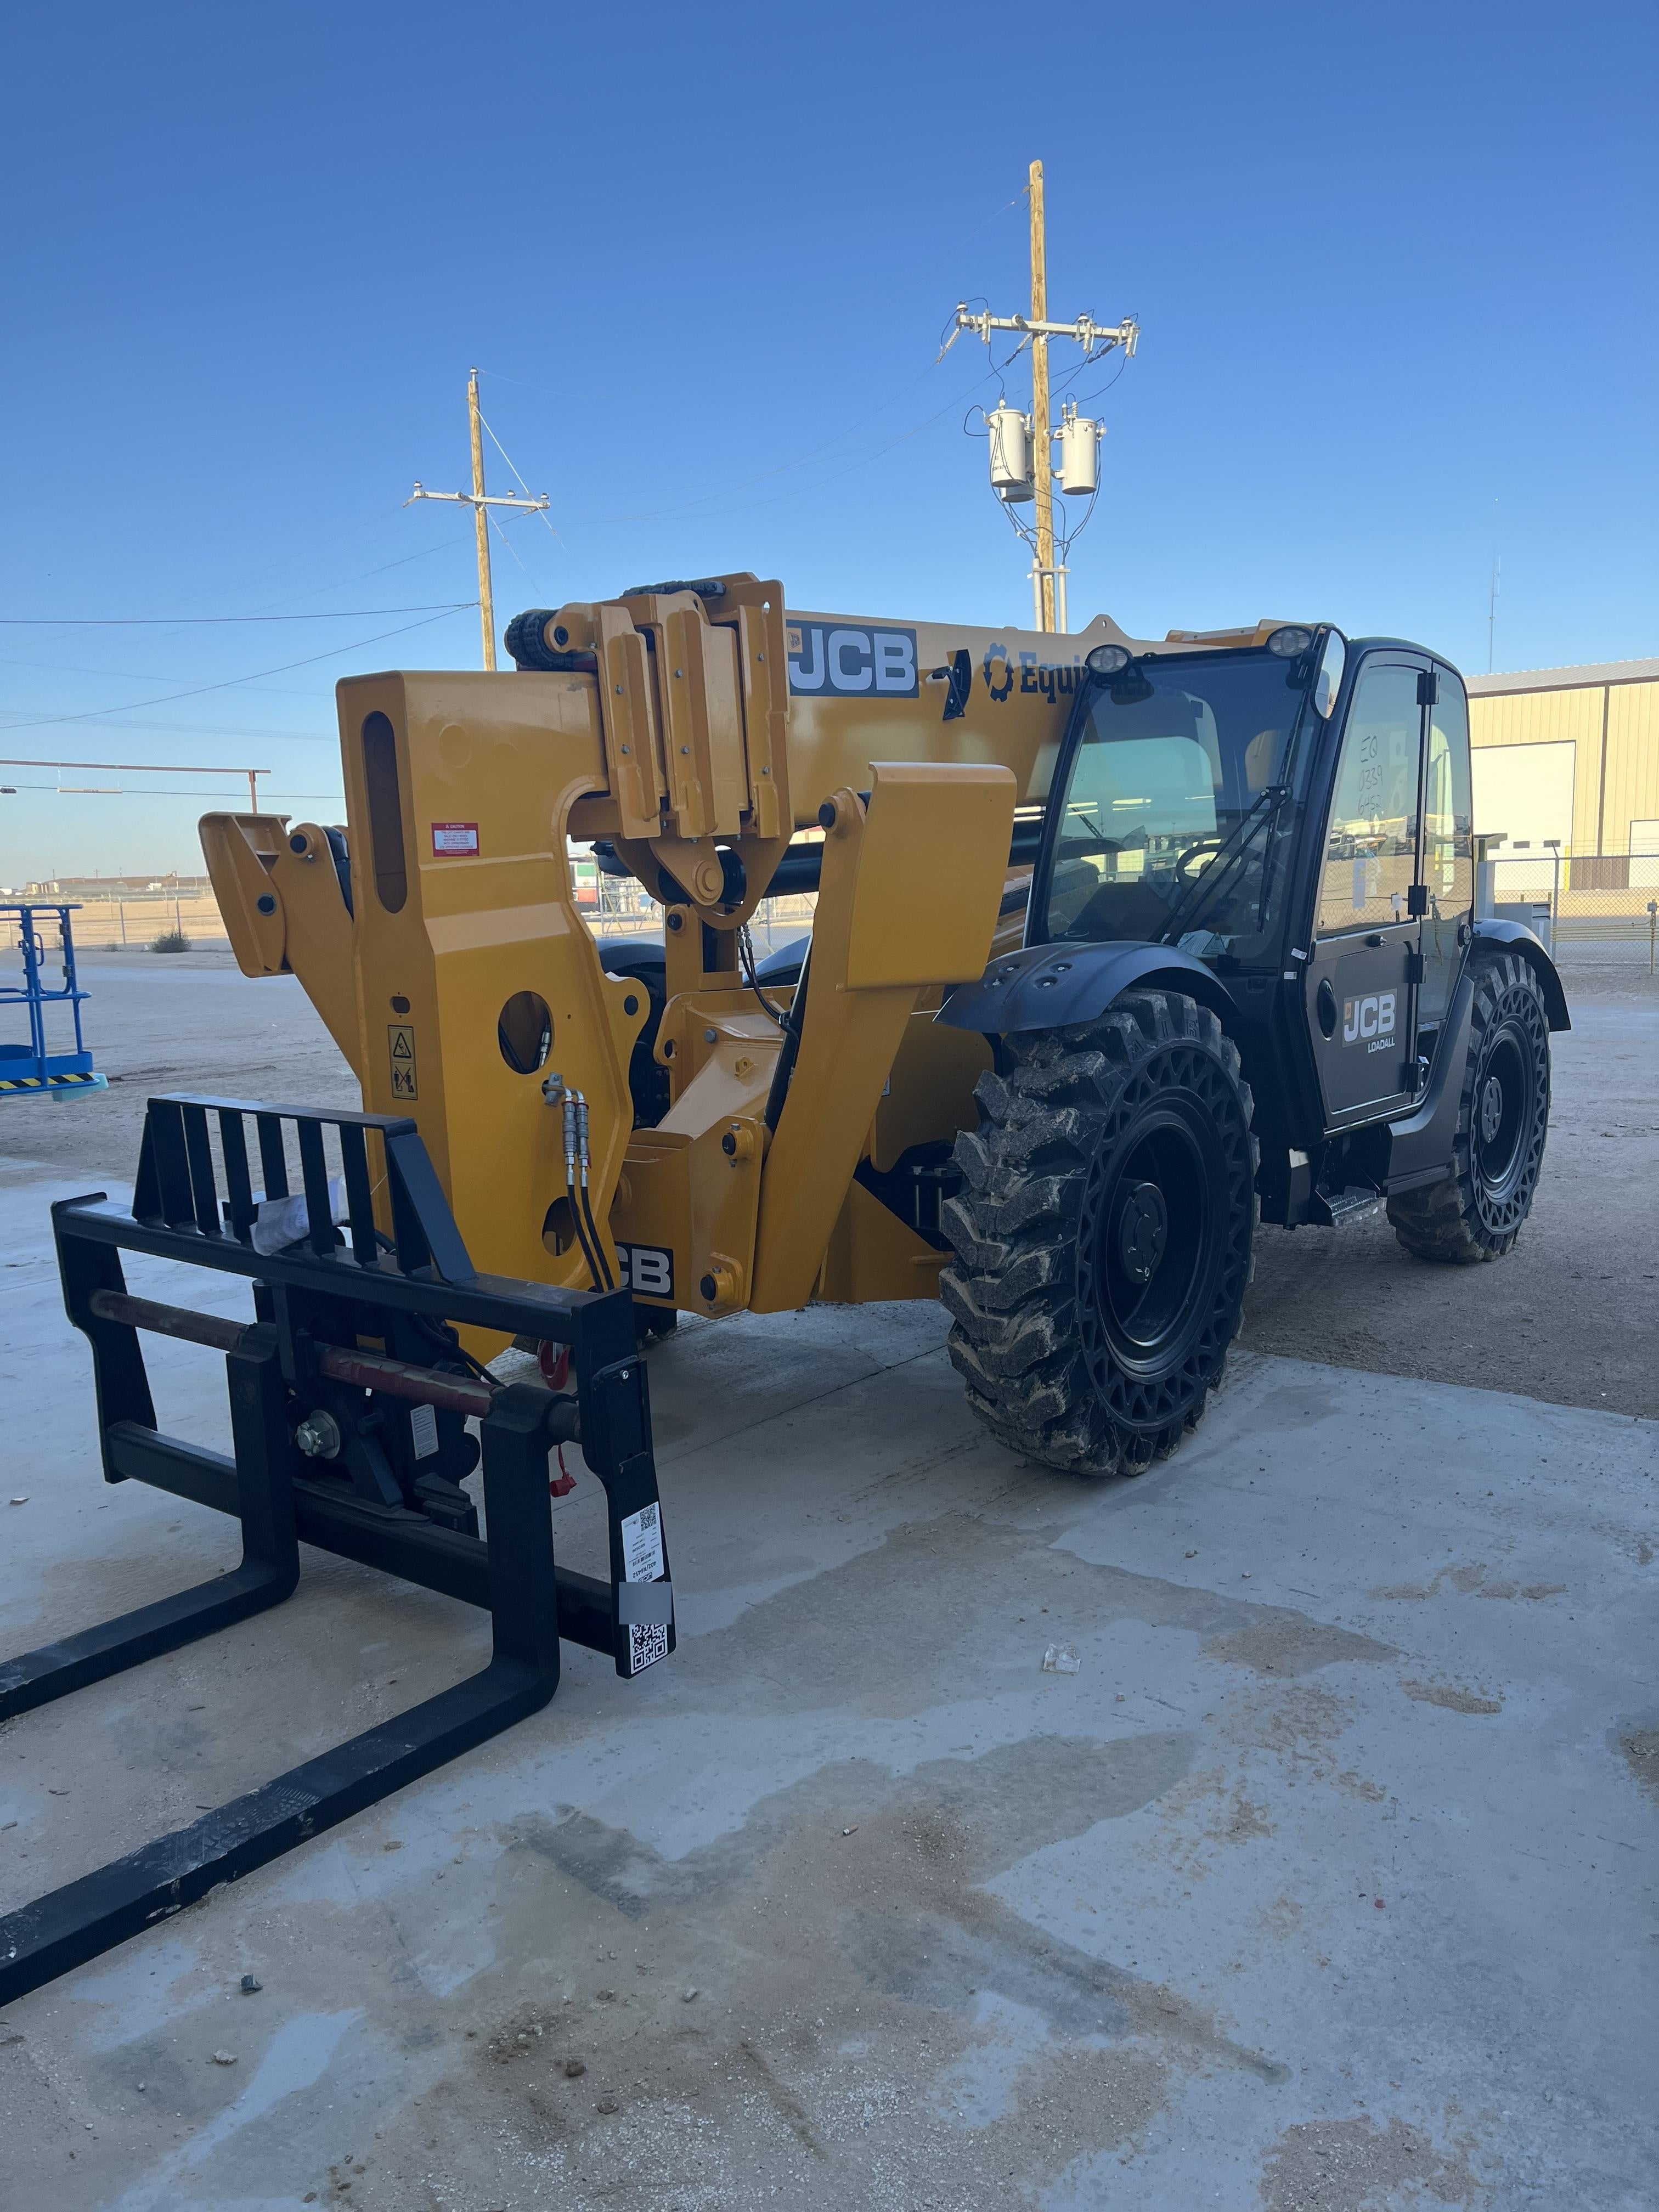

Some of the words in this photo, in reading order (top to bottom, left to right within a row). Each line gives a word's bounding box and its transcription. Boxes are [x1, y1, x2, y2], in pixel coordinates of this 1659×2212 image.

[788, 629, 916, 691] JCB
[1361, 735, 1378, 763] EQ
[1359, 765, 1384, 792] 0339
[1344, 994, 1395, 1042] JCB
[1368, 1036, 1396, 1053] LOADALL
